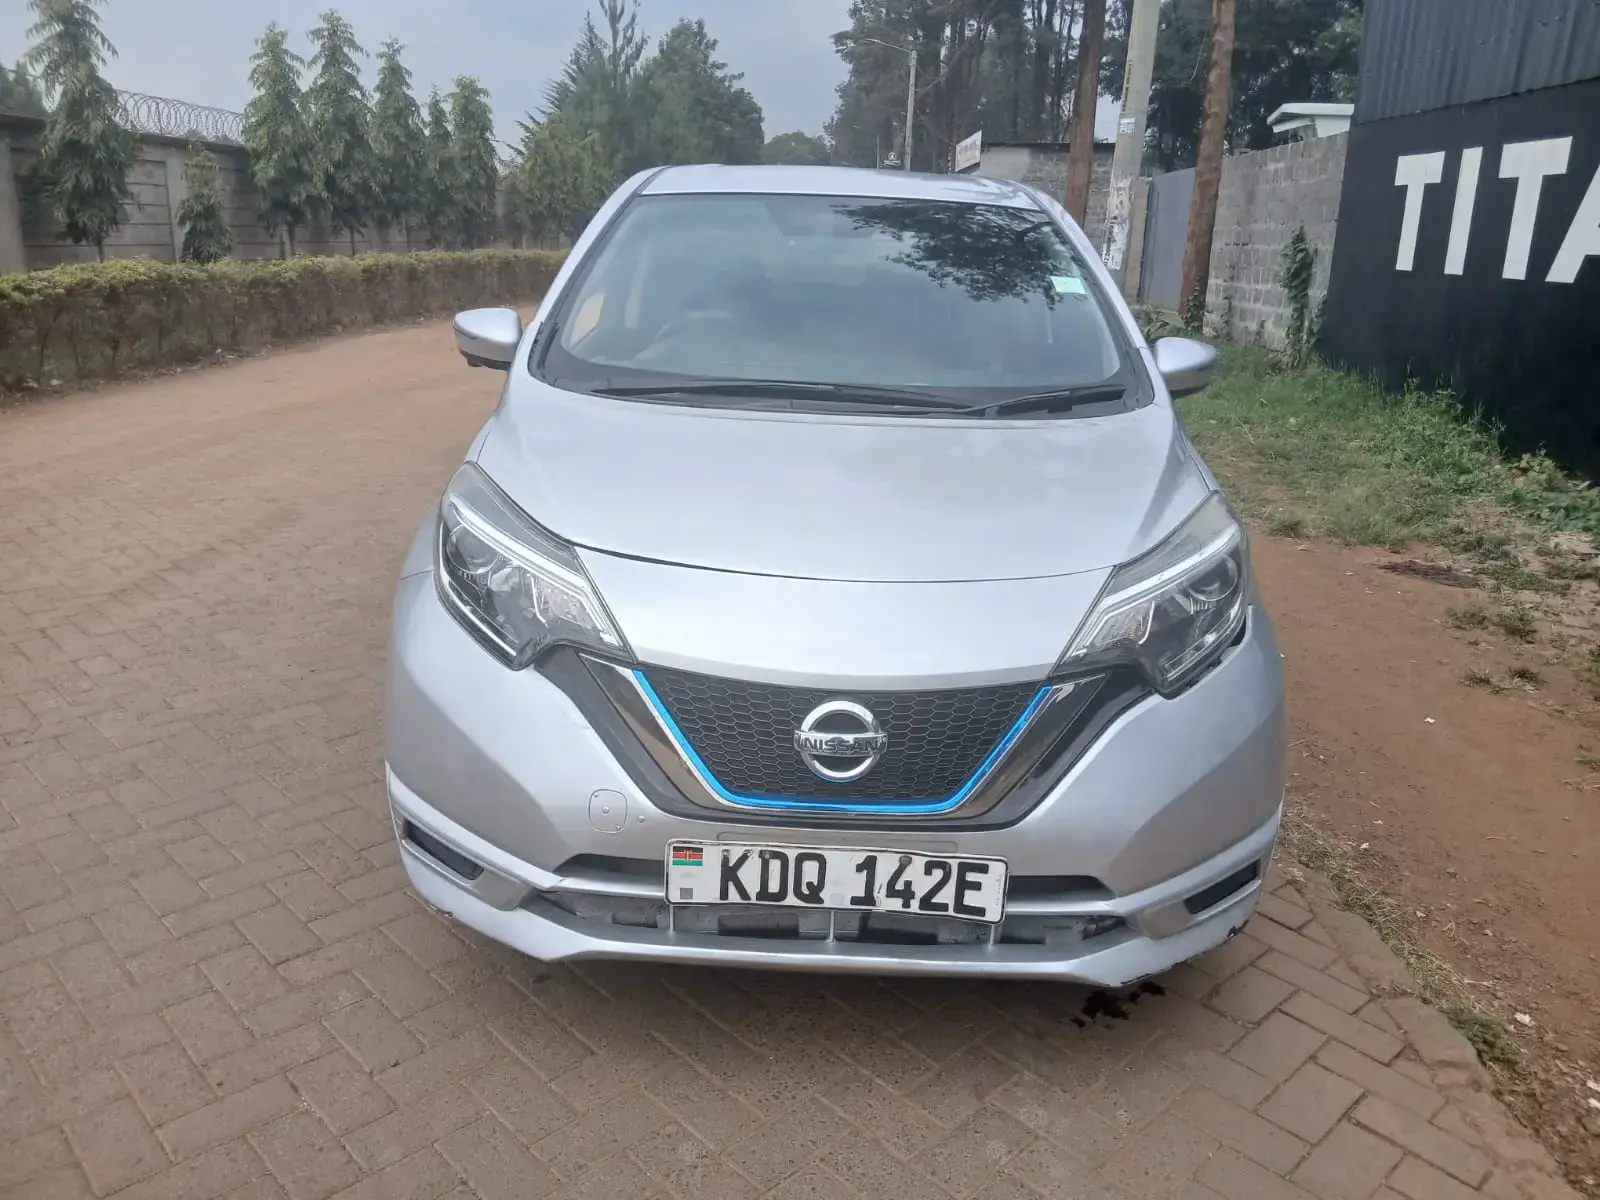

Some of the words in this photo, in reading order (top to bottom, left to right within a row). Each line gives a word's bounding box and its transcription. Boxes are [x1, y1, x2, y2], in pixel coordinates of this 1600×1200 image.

[802, 737, 878, 753] NISSAN
[719, 849, 827, 905] KDQ
[849, 854, 989, 917] 142E
